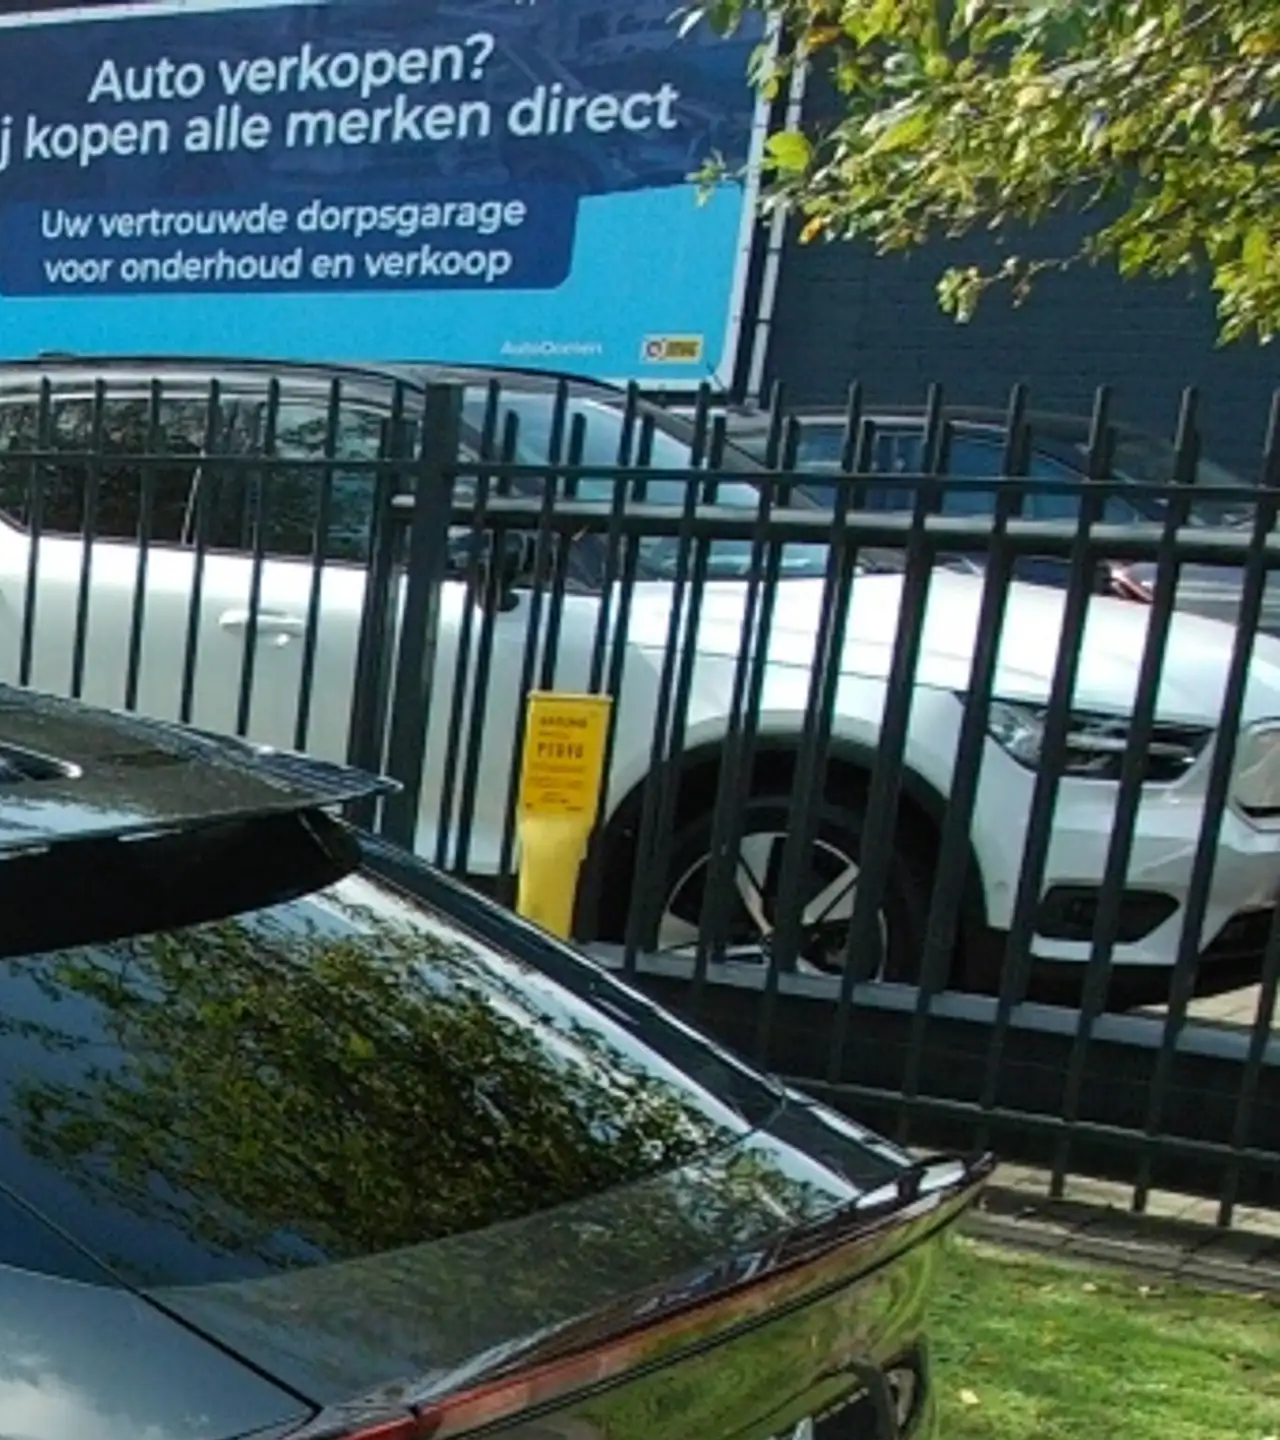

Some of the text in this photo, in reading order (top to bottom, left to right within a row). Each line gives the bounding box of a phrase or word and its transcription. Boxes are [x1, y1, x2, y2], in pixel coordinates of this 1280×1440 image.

[87, 32, 495, 104] Auto verkopen?
[24, 113, 170, 167] kopen
[184, 101, 272, 152] alle
[286, 94, 491, 147] merken
[507, 82, 680, 138] direct
[41, 199, 528, 239] Uw vertrouwde dorpsgarage
[43, 243, 513, 283] voor onderhoud en verkoop
